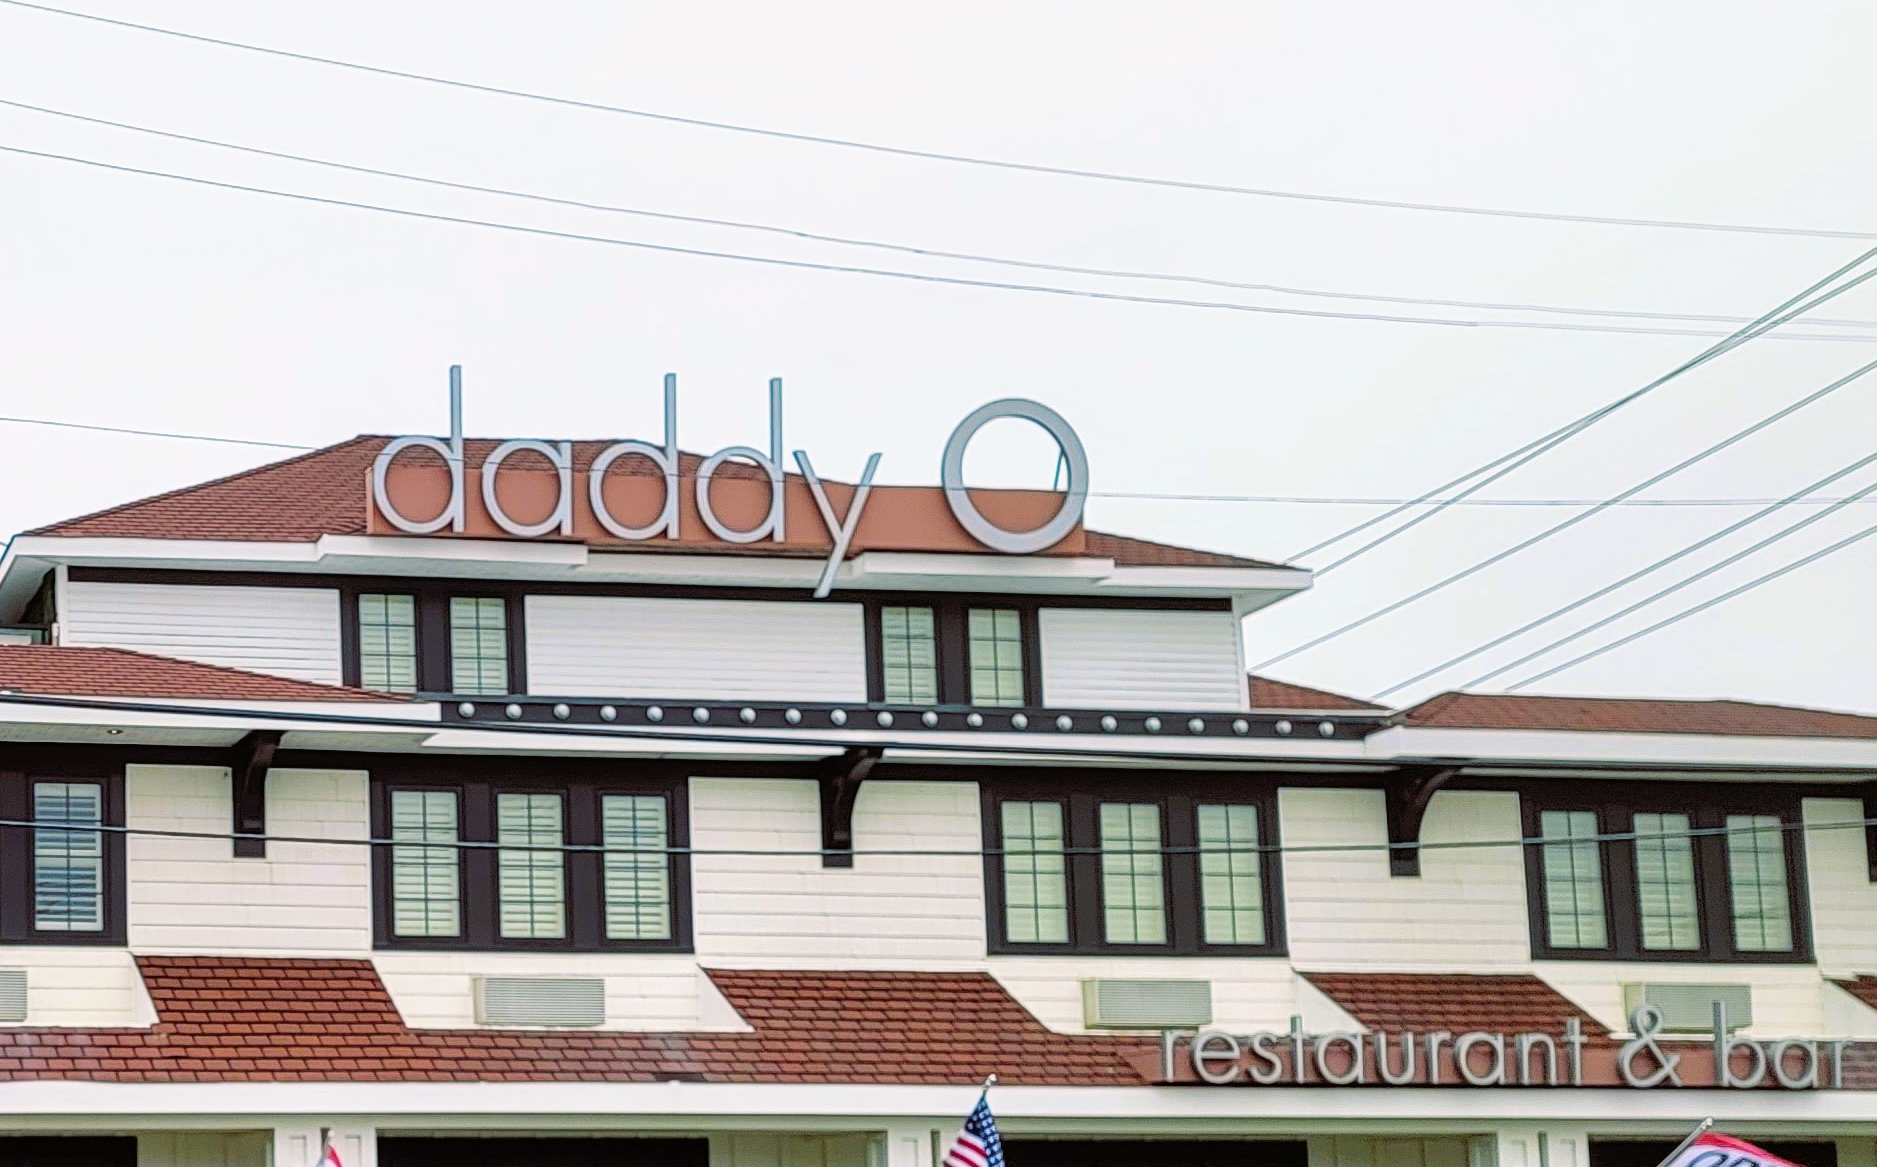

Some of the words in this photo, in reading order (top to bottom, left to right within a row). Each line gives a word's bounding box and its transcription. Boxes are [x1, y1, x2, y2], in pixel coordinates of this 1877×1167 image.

[373, 365, 881, 598] daddy
[942, 398, 1089, 554] O
[1160, 1015, 1588, 1087] restaurant
[1621, 1003, 1682, 1089] &
[1712, 1000, 1855, 1089] bar
